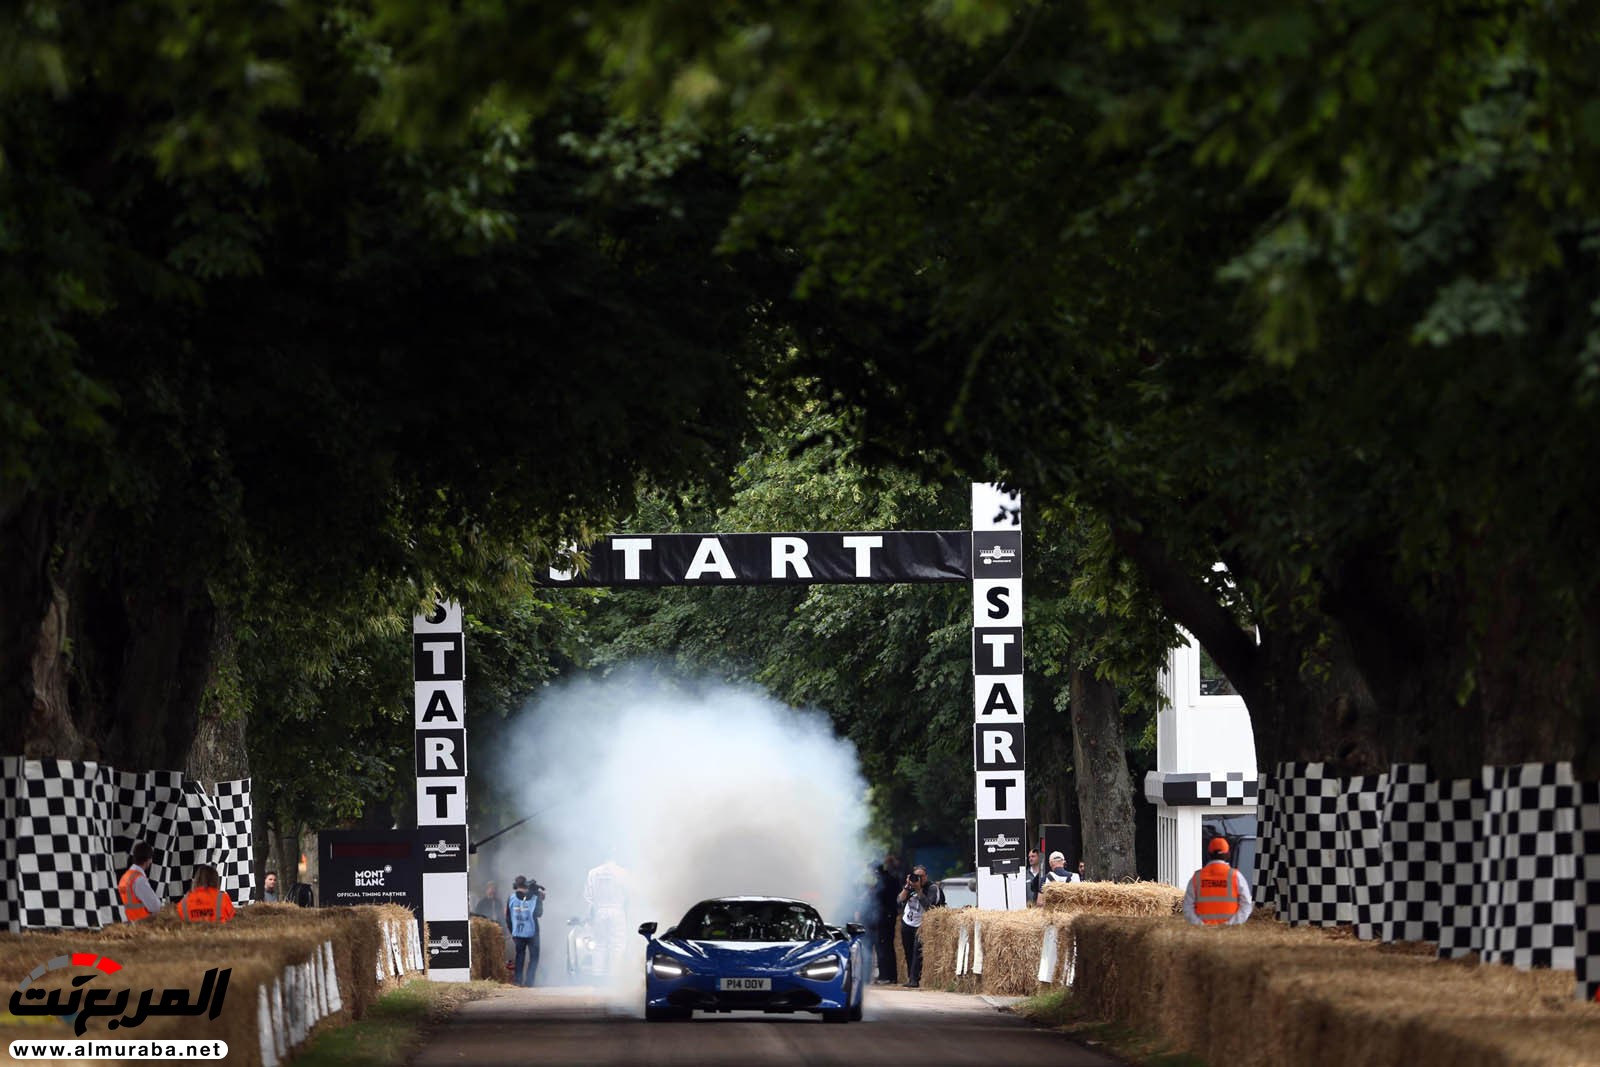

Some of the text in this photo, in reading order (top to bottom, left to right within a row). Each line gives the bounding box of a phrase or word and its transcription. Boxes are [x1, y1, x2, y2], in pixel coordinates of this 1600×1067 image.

[982, 586, 1018, 811] START
[355, 870, 385, 878] MONT
[355, 878, 385, 887] BLANC
[726, 979, 743, 989] P14
